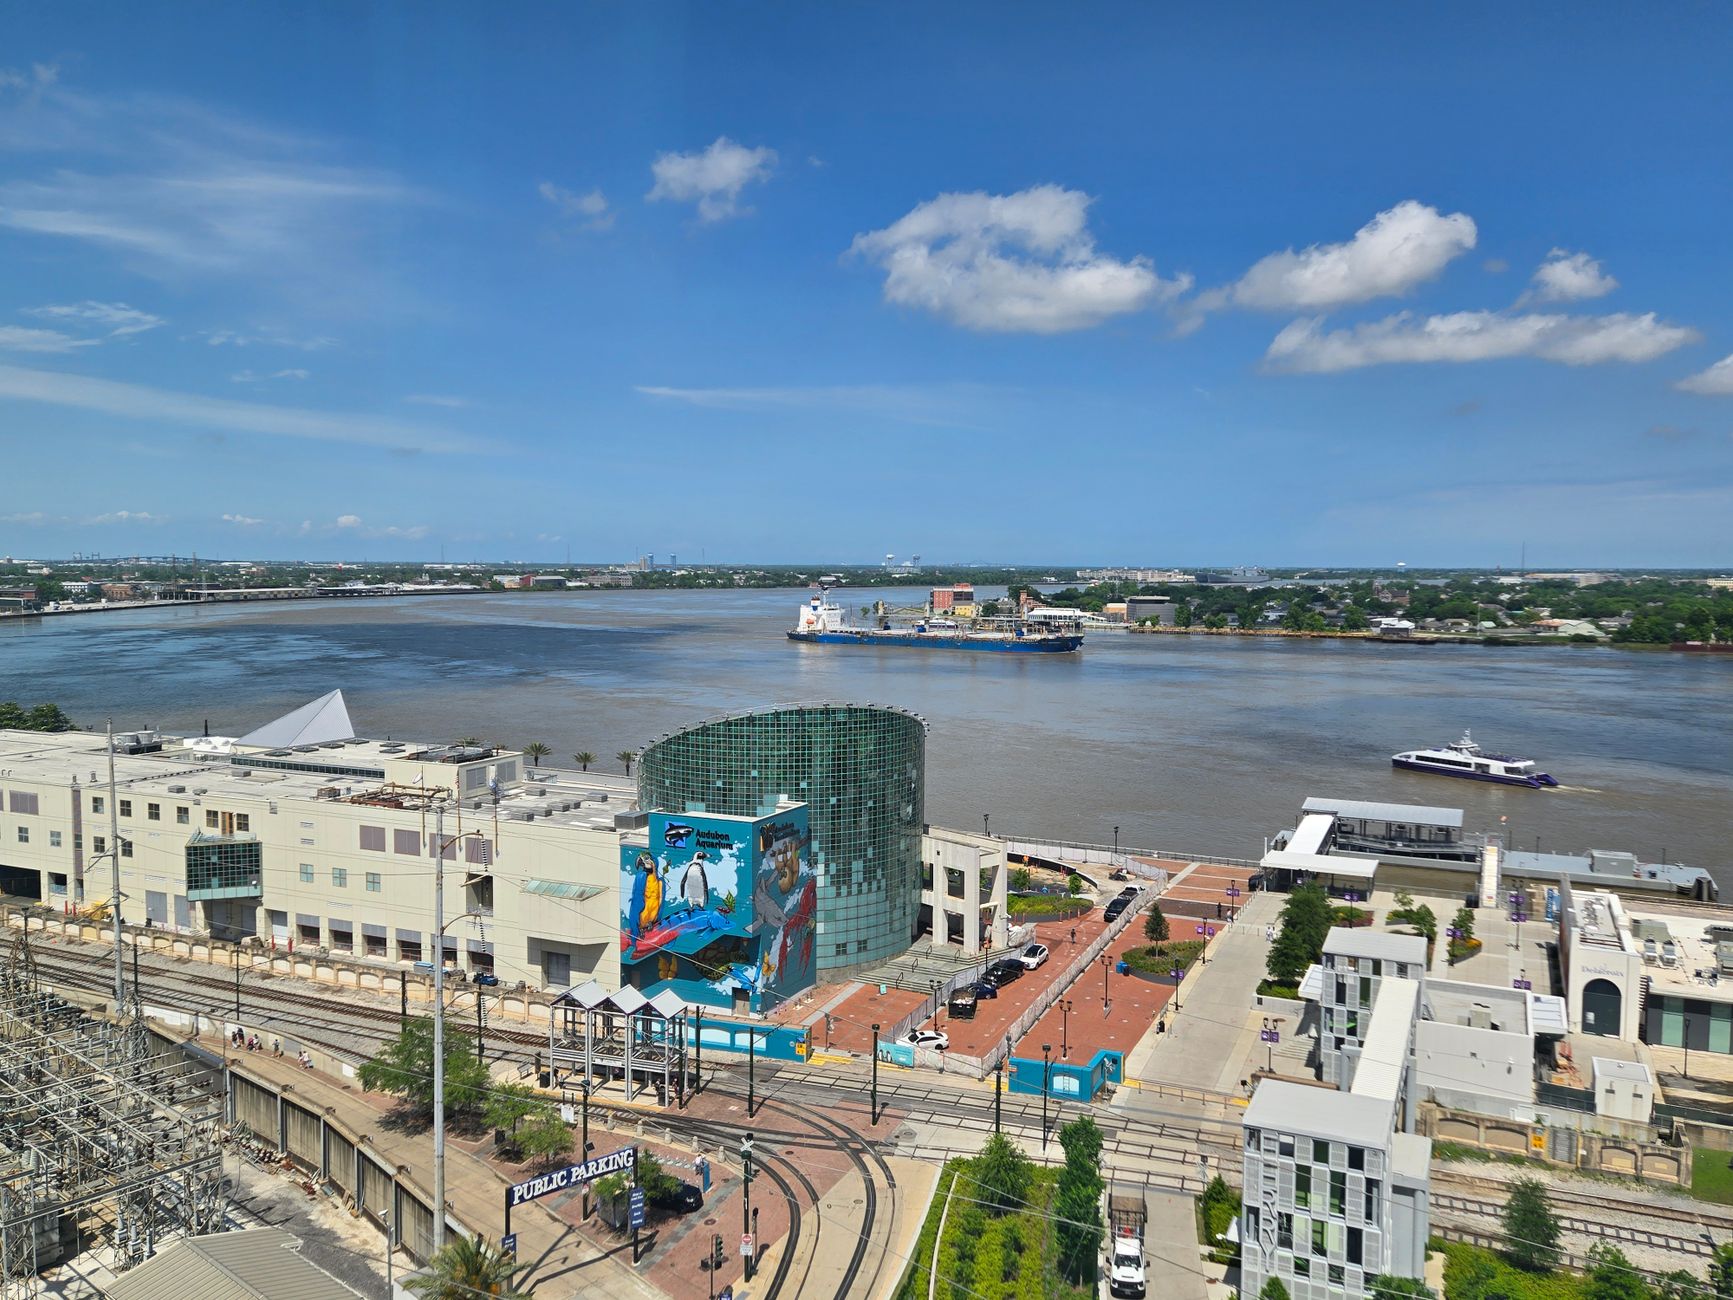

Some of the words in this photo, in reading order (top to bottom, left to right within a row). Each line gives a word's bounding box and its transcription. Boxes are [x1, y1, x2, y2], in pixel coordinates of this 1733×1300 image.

[695, 829, 730, 841] Audubon
[695, 838, 734, 850] Aquarium
[512, 1170, 567, 1205] PUBLIC
[570, 1148, 634, 1183] PARKING
